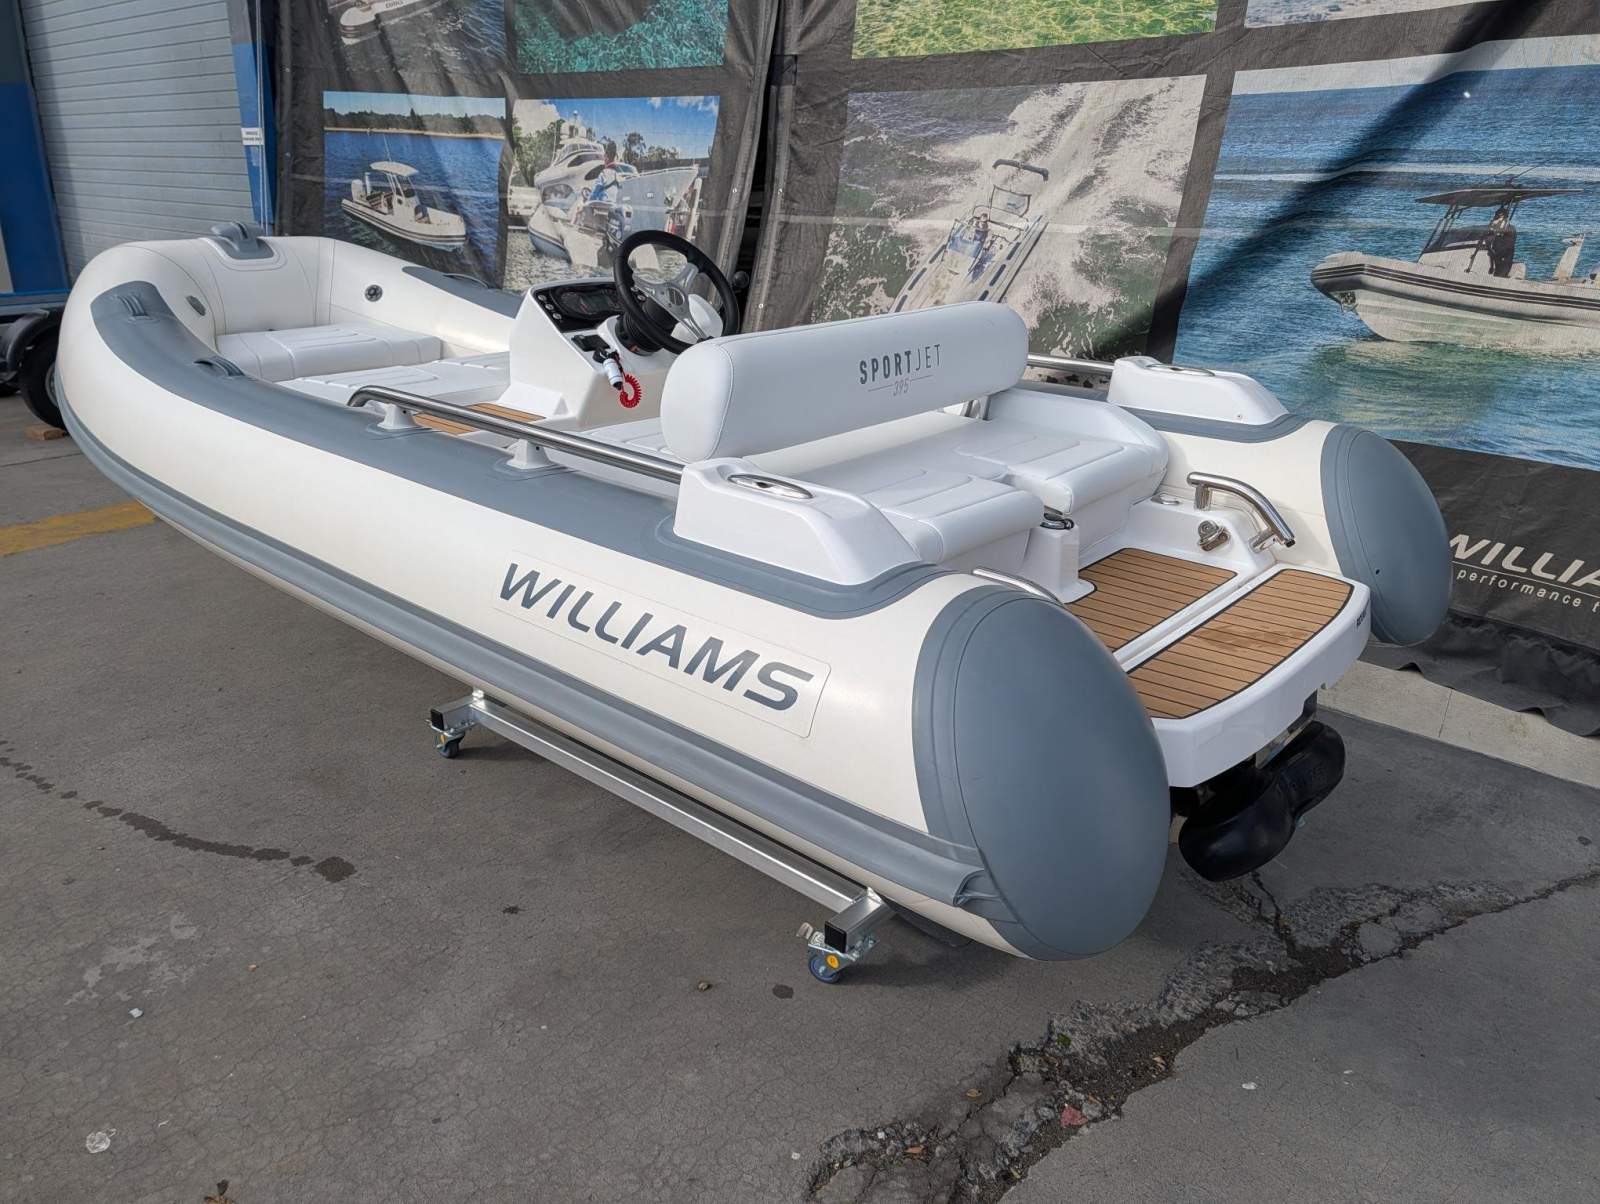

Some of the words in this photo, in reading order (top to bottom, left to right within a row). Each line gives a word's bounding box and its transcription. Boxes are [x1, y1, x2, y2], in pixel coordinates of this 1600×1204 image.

[860, 344, 940, 385] SPORTJET
[1456, 568, 1581, 607] performance
[499, 563, 814, 711] WILLIAMS
